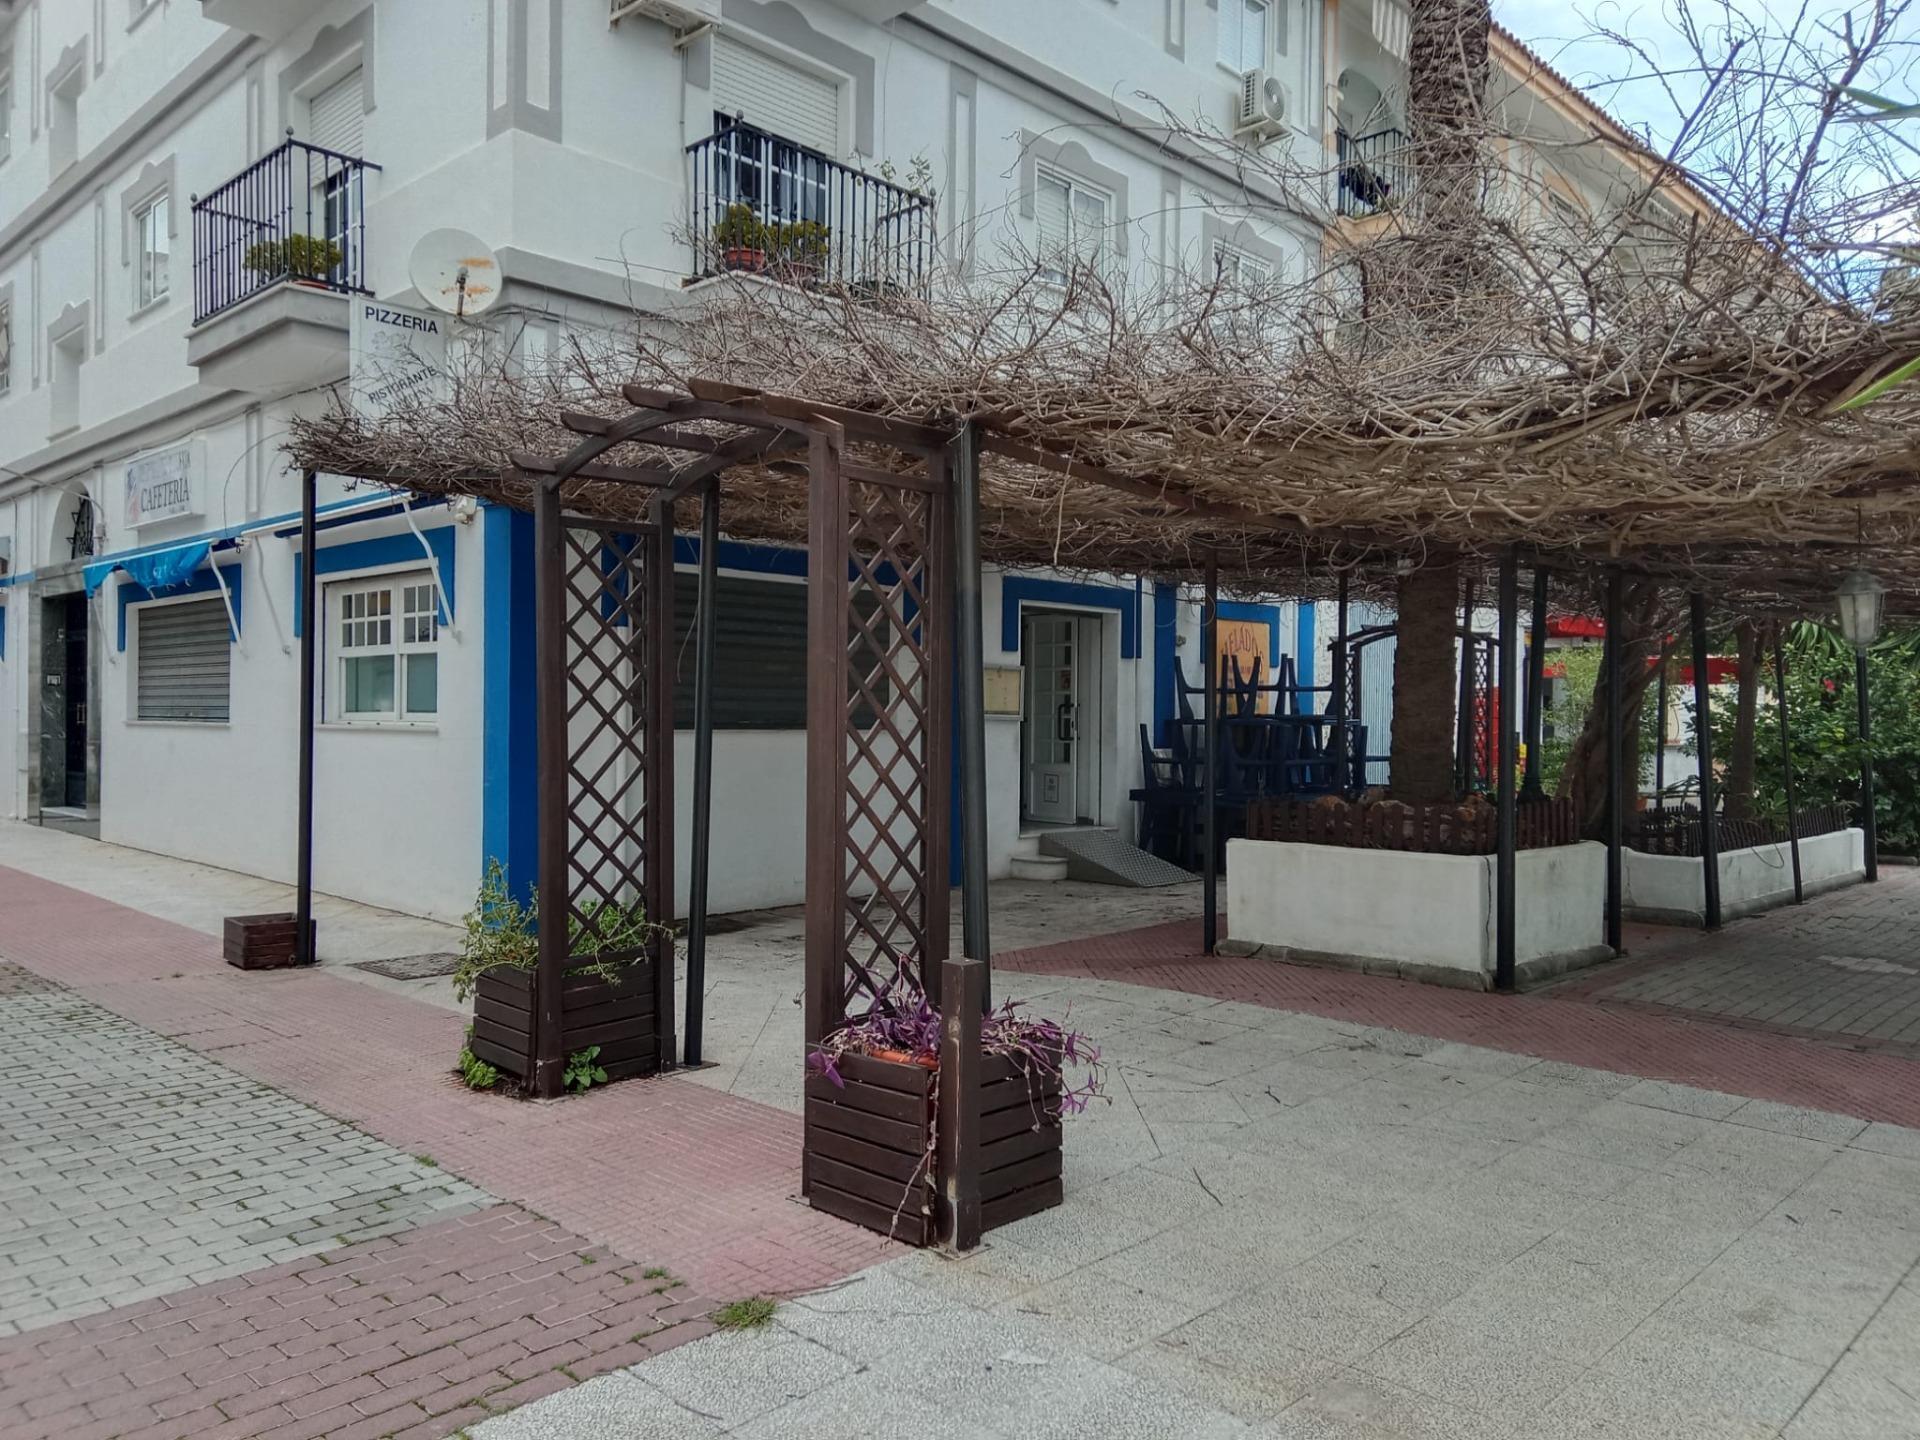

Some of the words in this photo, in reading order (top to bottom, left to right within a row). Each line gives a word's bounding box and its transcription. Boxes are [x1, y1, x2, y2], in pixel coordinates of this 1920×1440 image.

[365, 306, 438, 334] PIZZERIA
[368, 366, 437, 404] RISTORANTE
[141, 477, 190, 512] CAFETERIA
